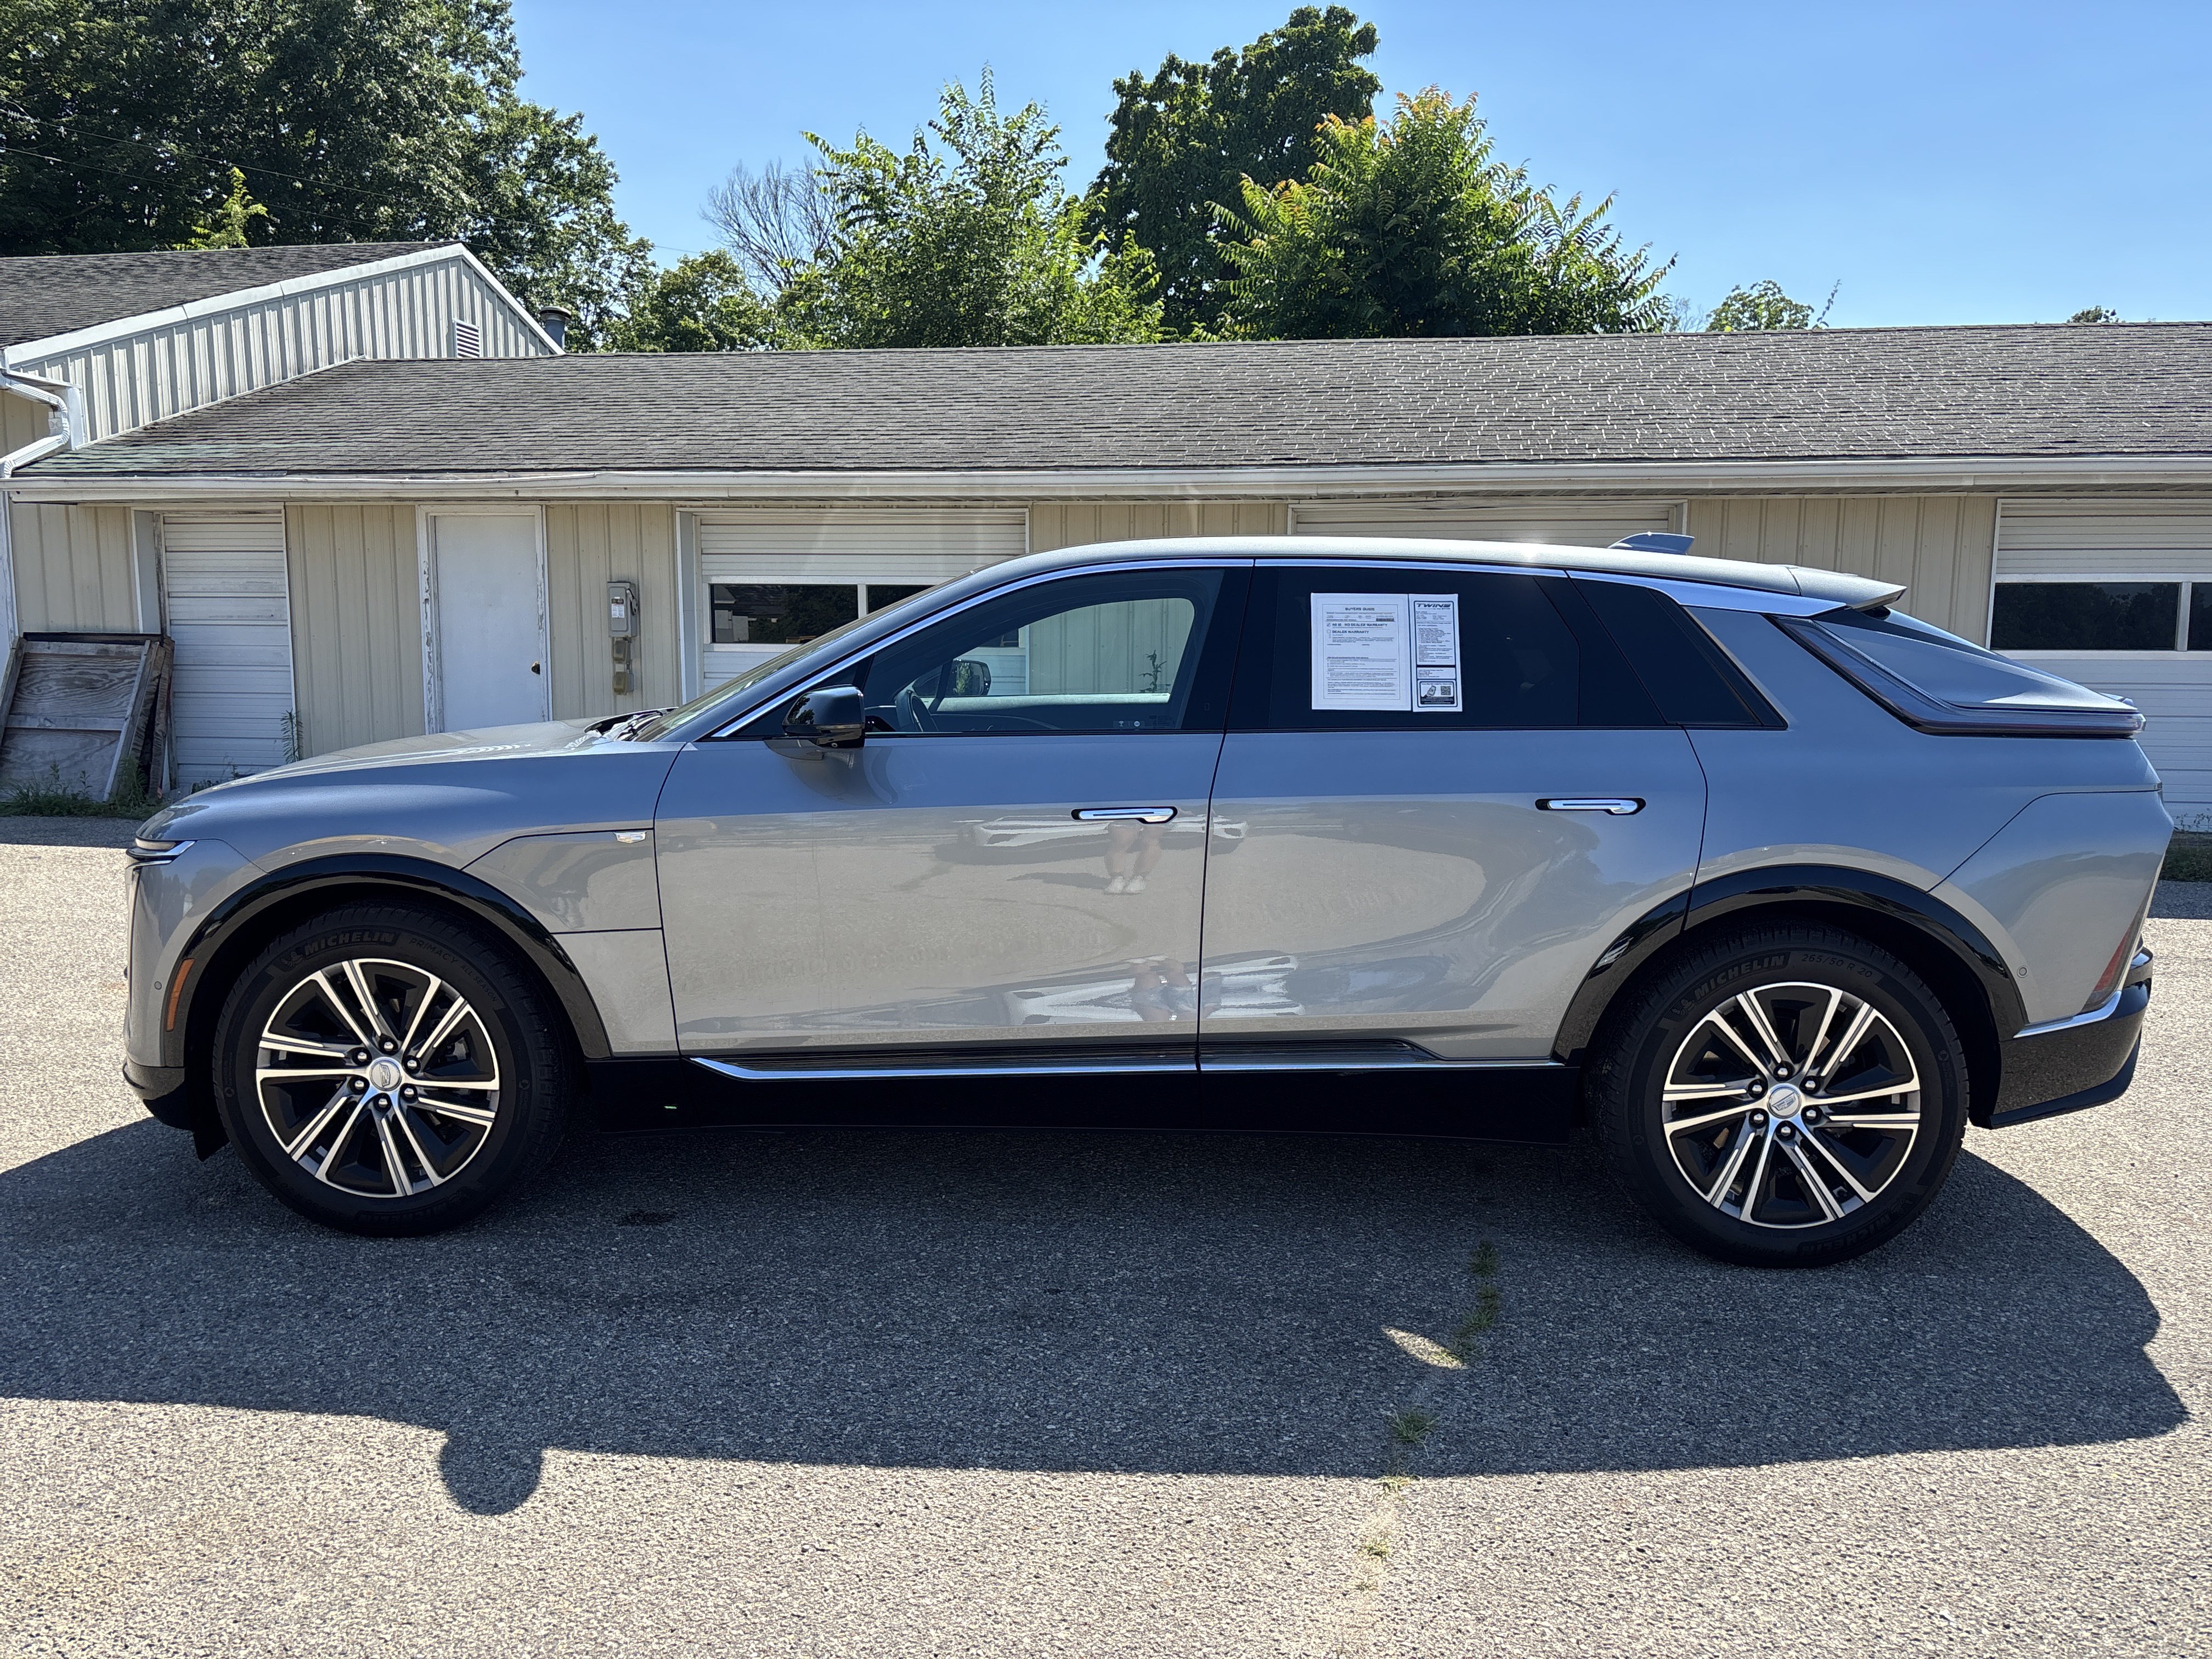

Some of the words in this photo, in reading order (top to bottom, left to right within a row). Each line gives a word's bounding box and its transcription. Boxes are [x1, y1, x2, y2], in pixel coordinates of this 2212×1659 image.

[304, 931, 397, 957] MICHELIN
[408, 937, 459, 964] PRIMACY
[460, 964, 473, 977] ALL
[472, 975, 499, 1002] SEASON
[1694, 955, 1786, 1000] MICHELIN
[1801, 953, 1845, 967] 265/50
[1846, 962, 1855, 971] R
[1857, 967, 1874, 978] 20
